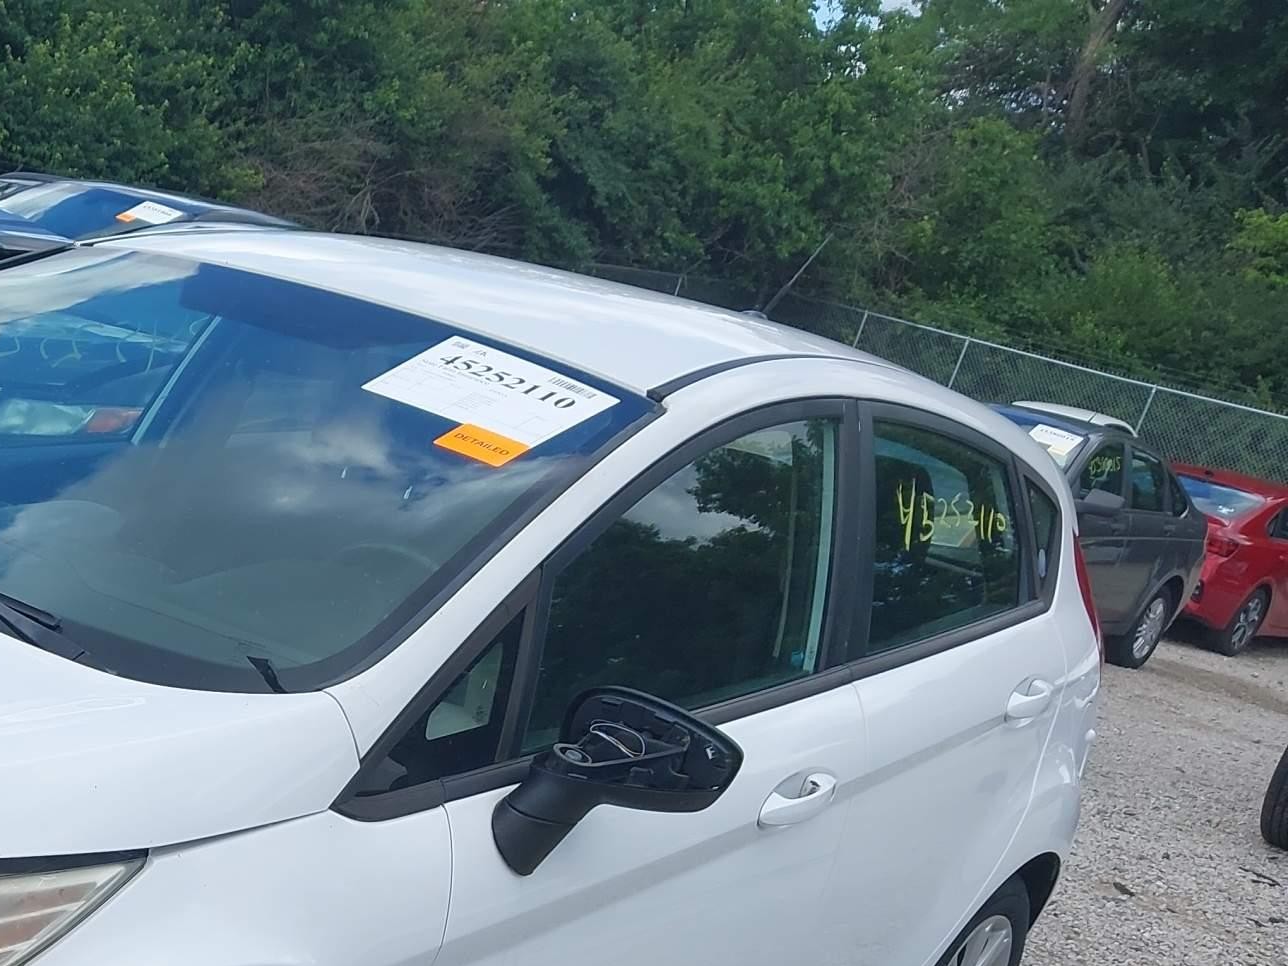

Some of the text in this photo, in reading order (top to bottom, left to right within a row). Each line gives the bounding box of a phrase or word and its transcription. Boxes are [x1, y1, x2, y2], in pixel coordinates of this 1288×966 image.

[439, 354, 576, 409] 45252110
[453, 431, 510, 456] DETAILED
[896, 478, 1006, 552] 45252110
